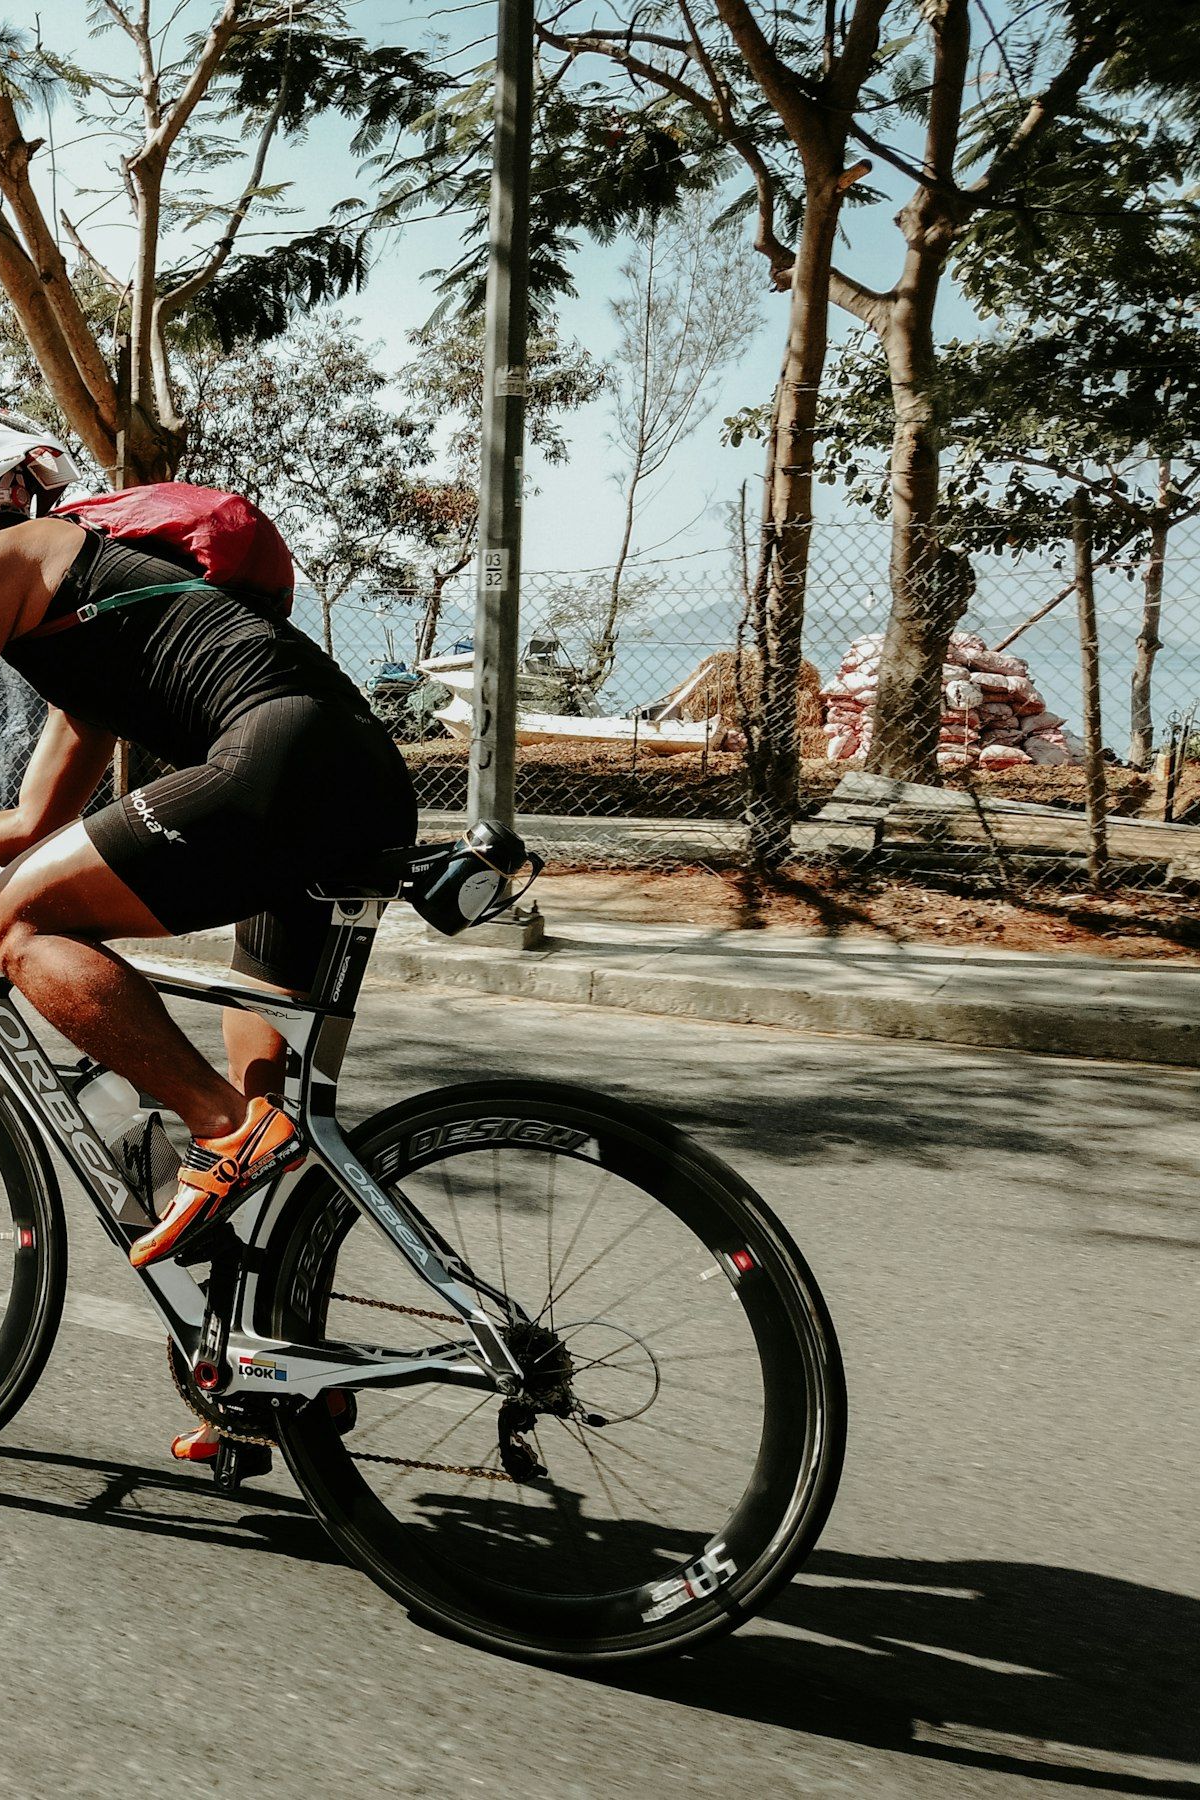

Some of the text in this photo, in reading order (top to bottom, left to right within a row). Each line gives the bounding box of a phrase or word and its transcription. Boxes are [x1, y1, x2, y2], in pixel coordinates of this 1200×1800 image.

[485, 553, 501, 567] 03
[485, 572, 502, 586] 32
[411, 864, 430, 874] ism
[408, 1116, 593, 1162] DESIGN
[343, 1162, 429, 1267] ORBEA
[239, 1365, 274, 1380] LOOK
